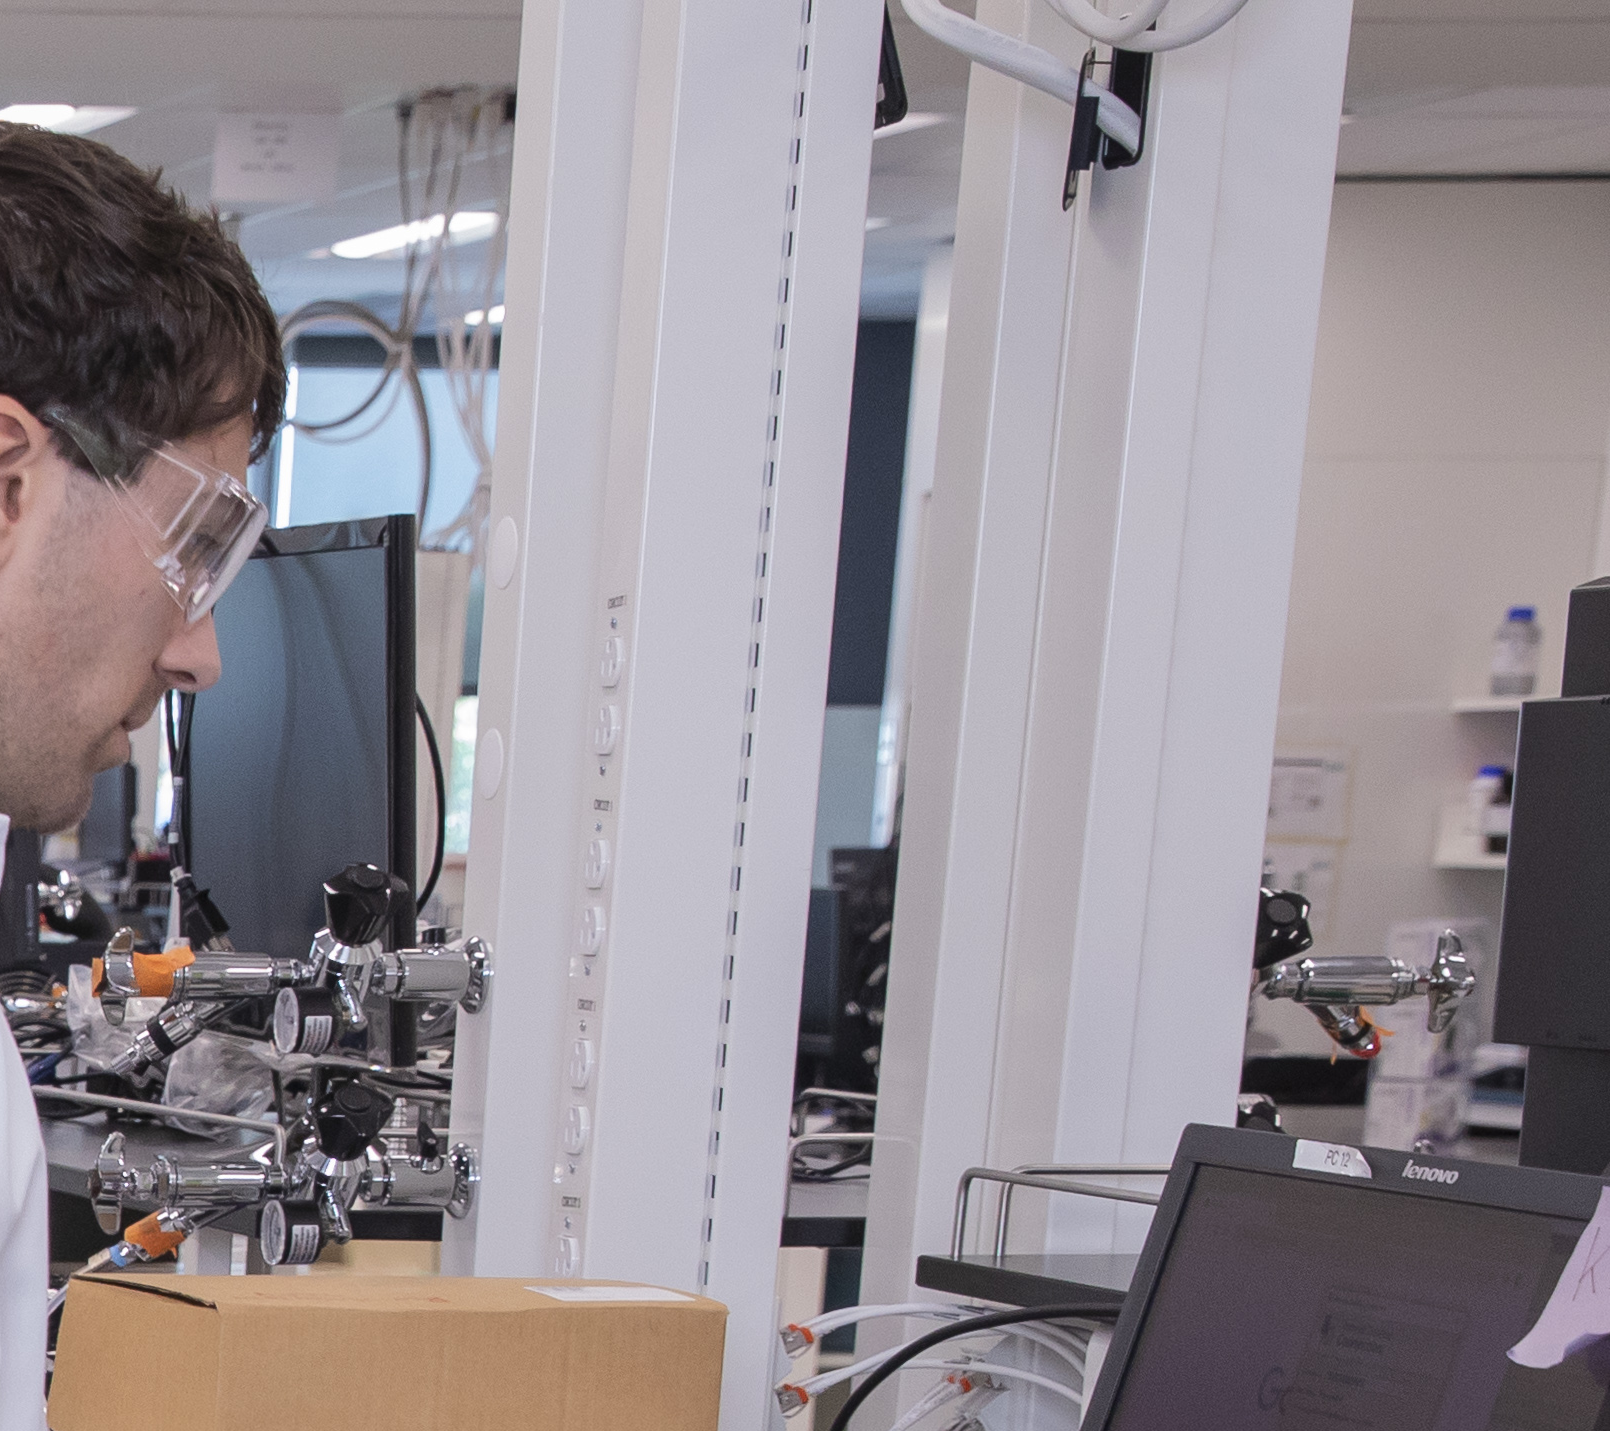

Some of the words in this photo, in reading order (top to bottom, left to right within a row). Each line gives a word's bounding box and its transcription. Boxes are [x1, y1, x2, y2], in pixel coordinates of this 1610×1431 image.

[1324, 1149, 1339, 1166] PC
[1340, 1150, 1351, 1168] 12
[1402, 1159, 1459, 1185] lenovo
